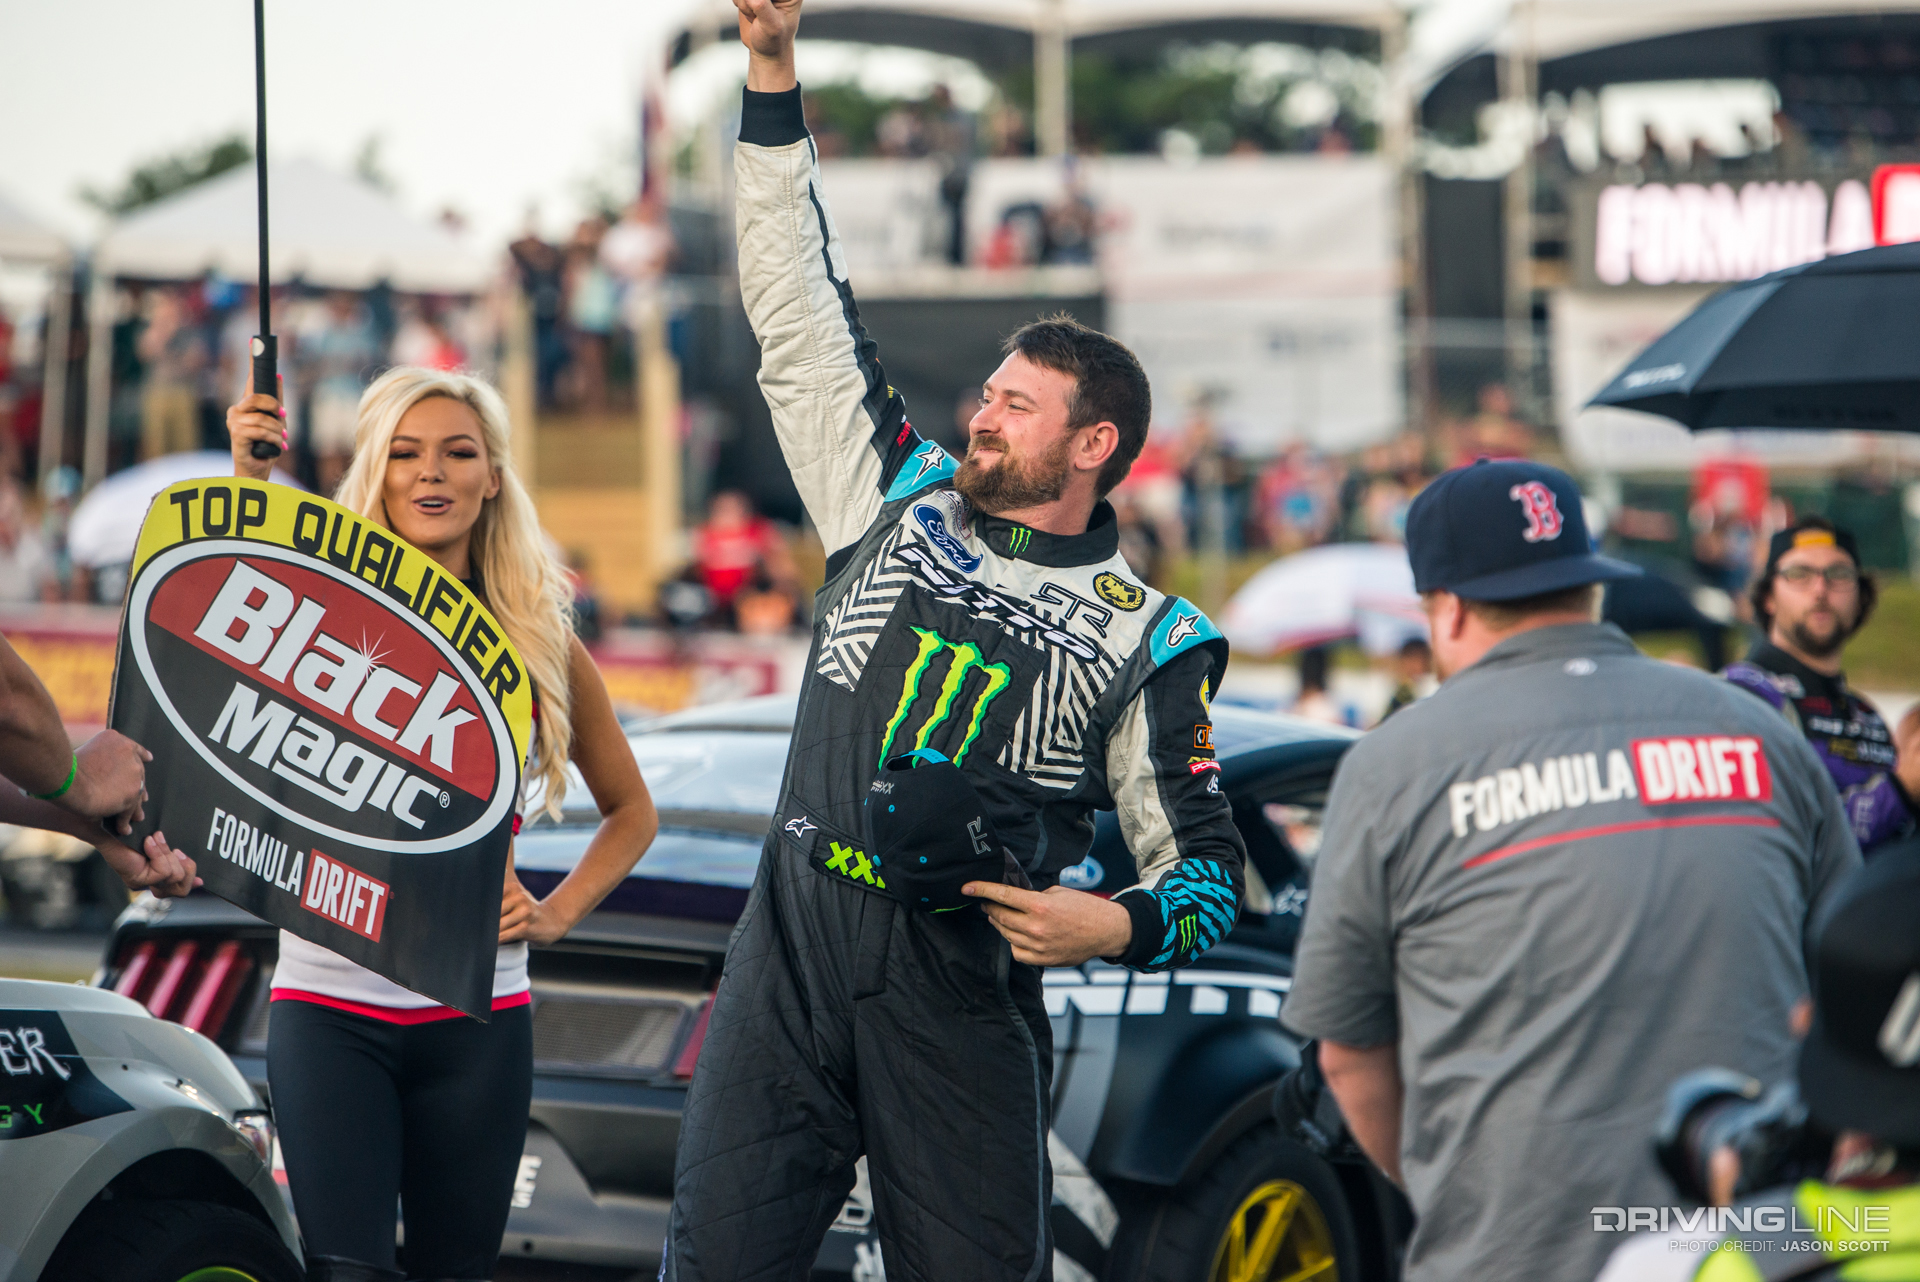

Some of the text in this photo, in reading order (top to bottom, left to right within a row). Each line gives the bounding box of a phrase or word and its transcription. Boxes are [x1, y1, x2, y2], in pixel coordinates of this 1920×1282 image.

[926, 518, 973, 569] Ford
[1510, 480, 1564, 543] B
[170, 486, 522, 698] TOP QUALIFIER
[193, 558, 478, 774] Black
[1449, 738, 1762, 838] FORMULA DRIFT
[206, 806, 386, 936] FORMULA DRIFT
